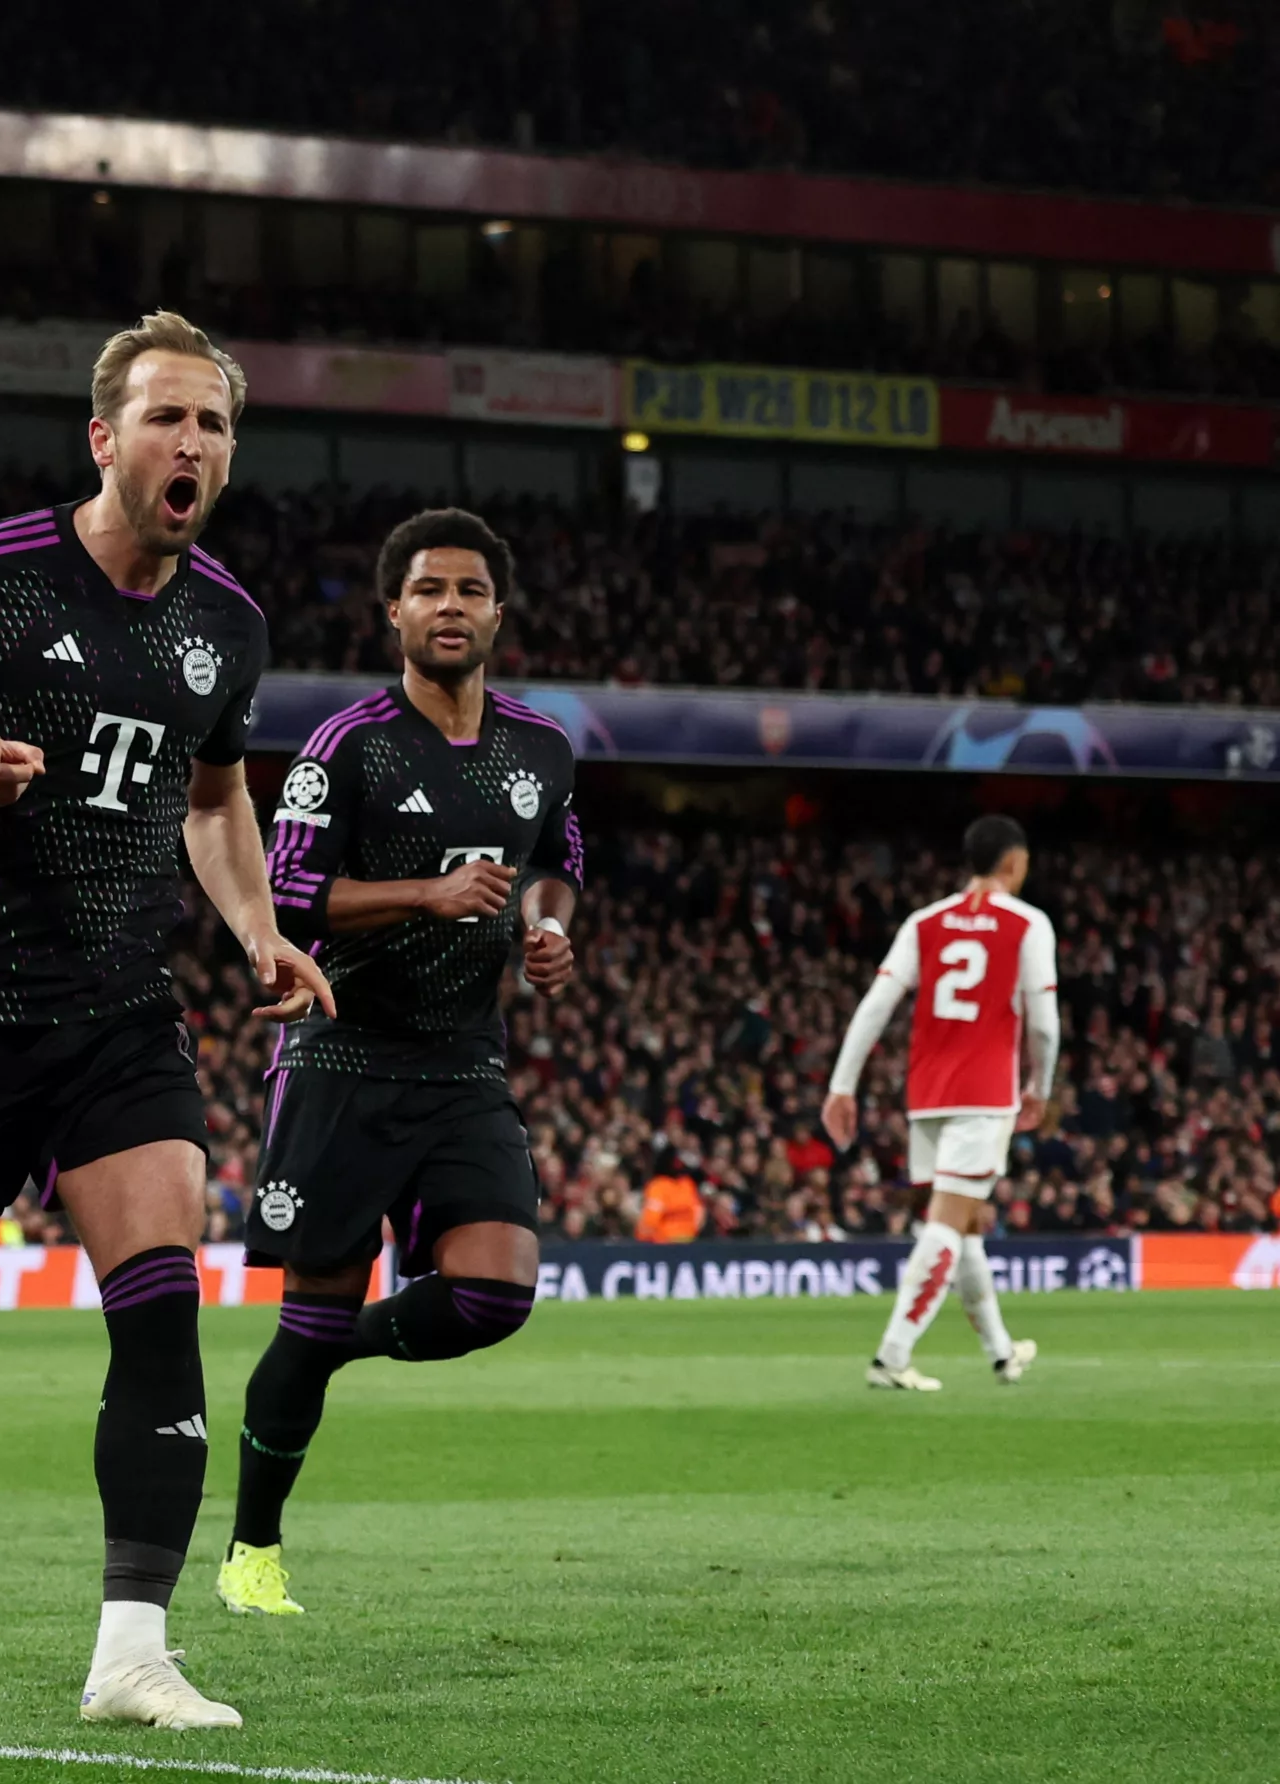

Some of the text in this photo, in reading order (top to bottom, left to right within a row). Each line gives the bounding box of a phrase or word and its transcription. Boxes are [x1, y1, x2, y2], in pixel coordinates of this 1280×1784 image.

[985, 395, 1124, 451] Arsenal
[80, 711, 166, 813] T
[933, 939, 988, 1022] 2
[535, 1261, 590, 1302] FA
[601, 1257, 884, 1302] CHAMPIONS
